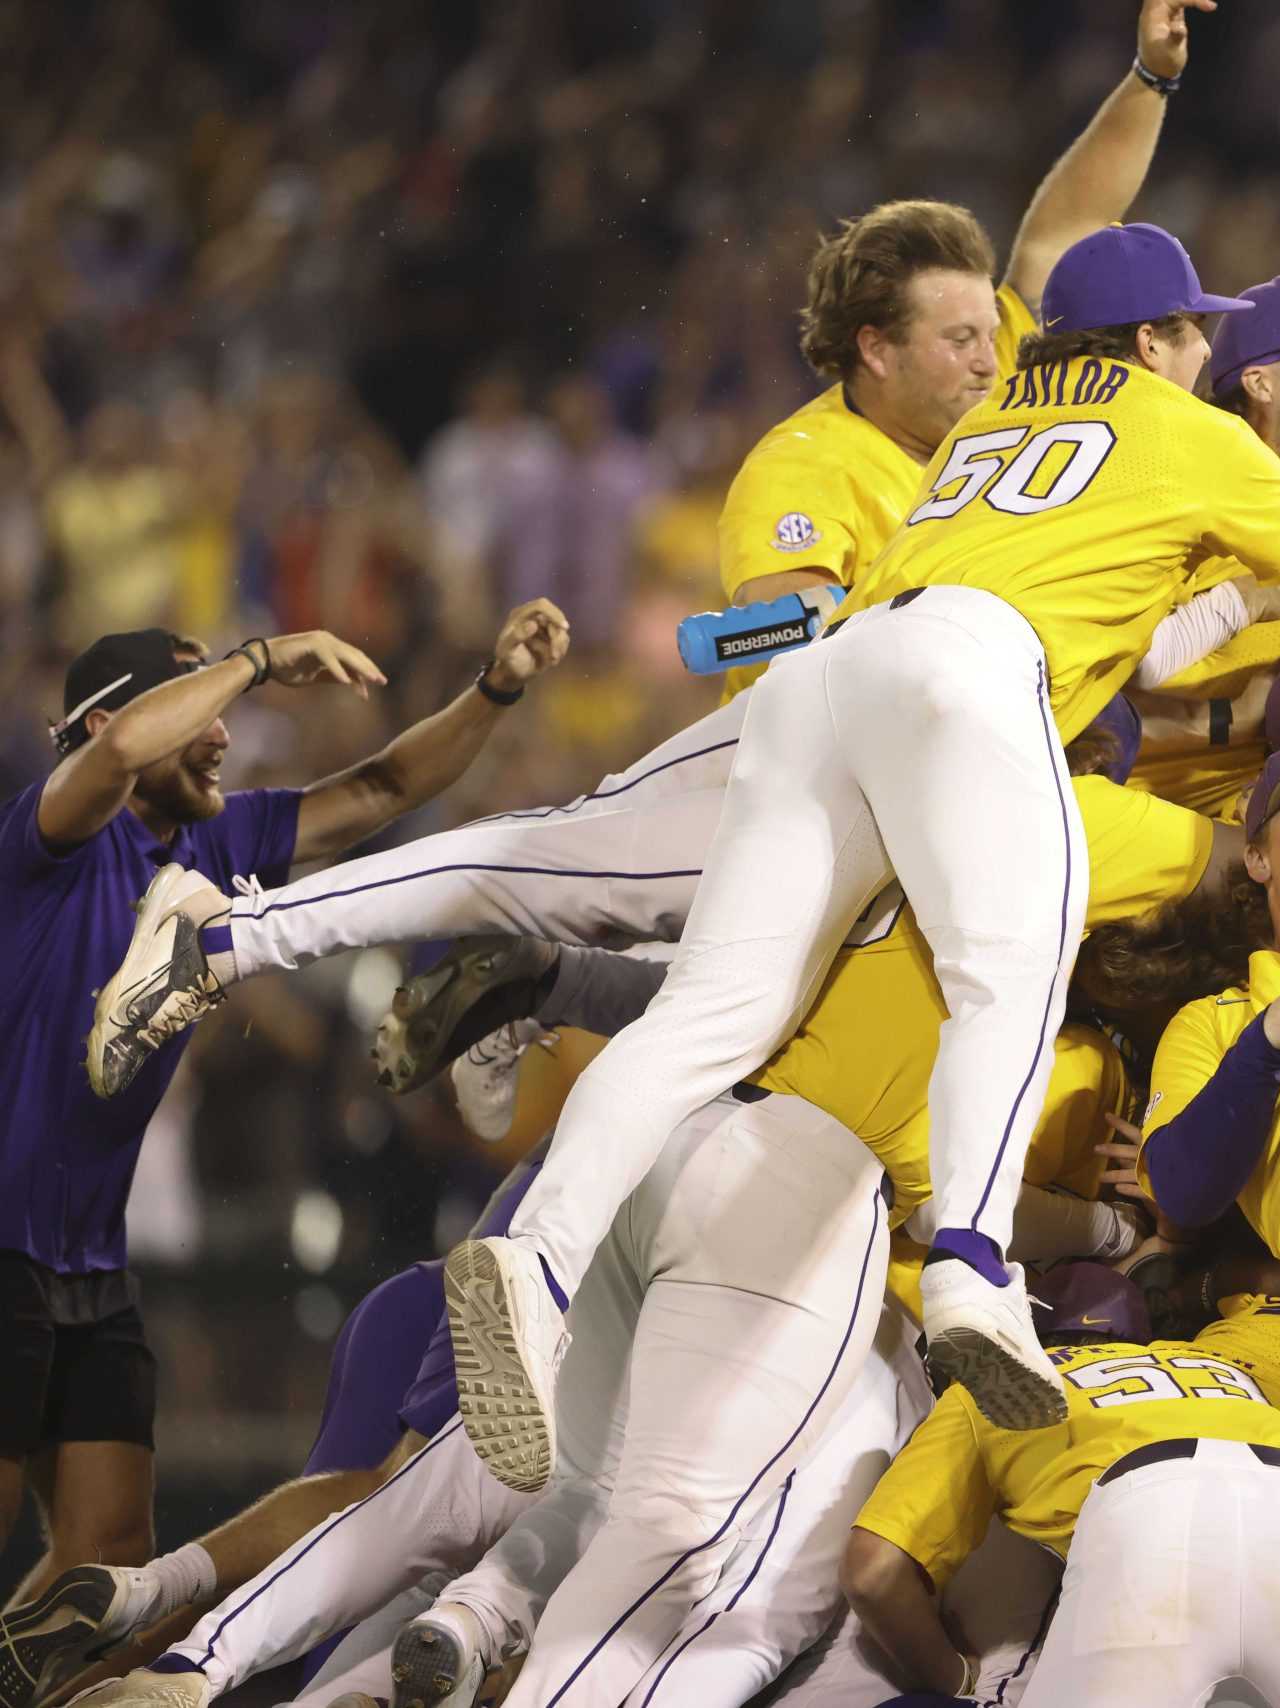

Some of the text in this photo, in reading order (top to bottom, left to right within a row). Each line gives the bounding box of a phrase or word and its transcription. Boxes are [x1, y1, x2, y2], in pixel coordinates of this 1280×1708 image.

[1000, 359, 1129, 411] TAYLOR
[906, 421, 1118, 527] 50
[777, 514, 814, 543] SEC
[721, 625, 804, 656] POWERADE
[1063, 1353, 1272, 1409] 53
